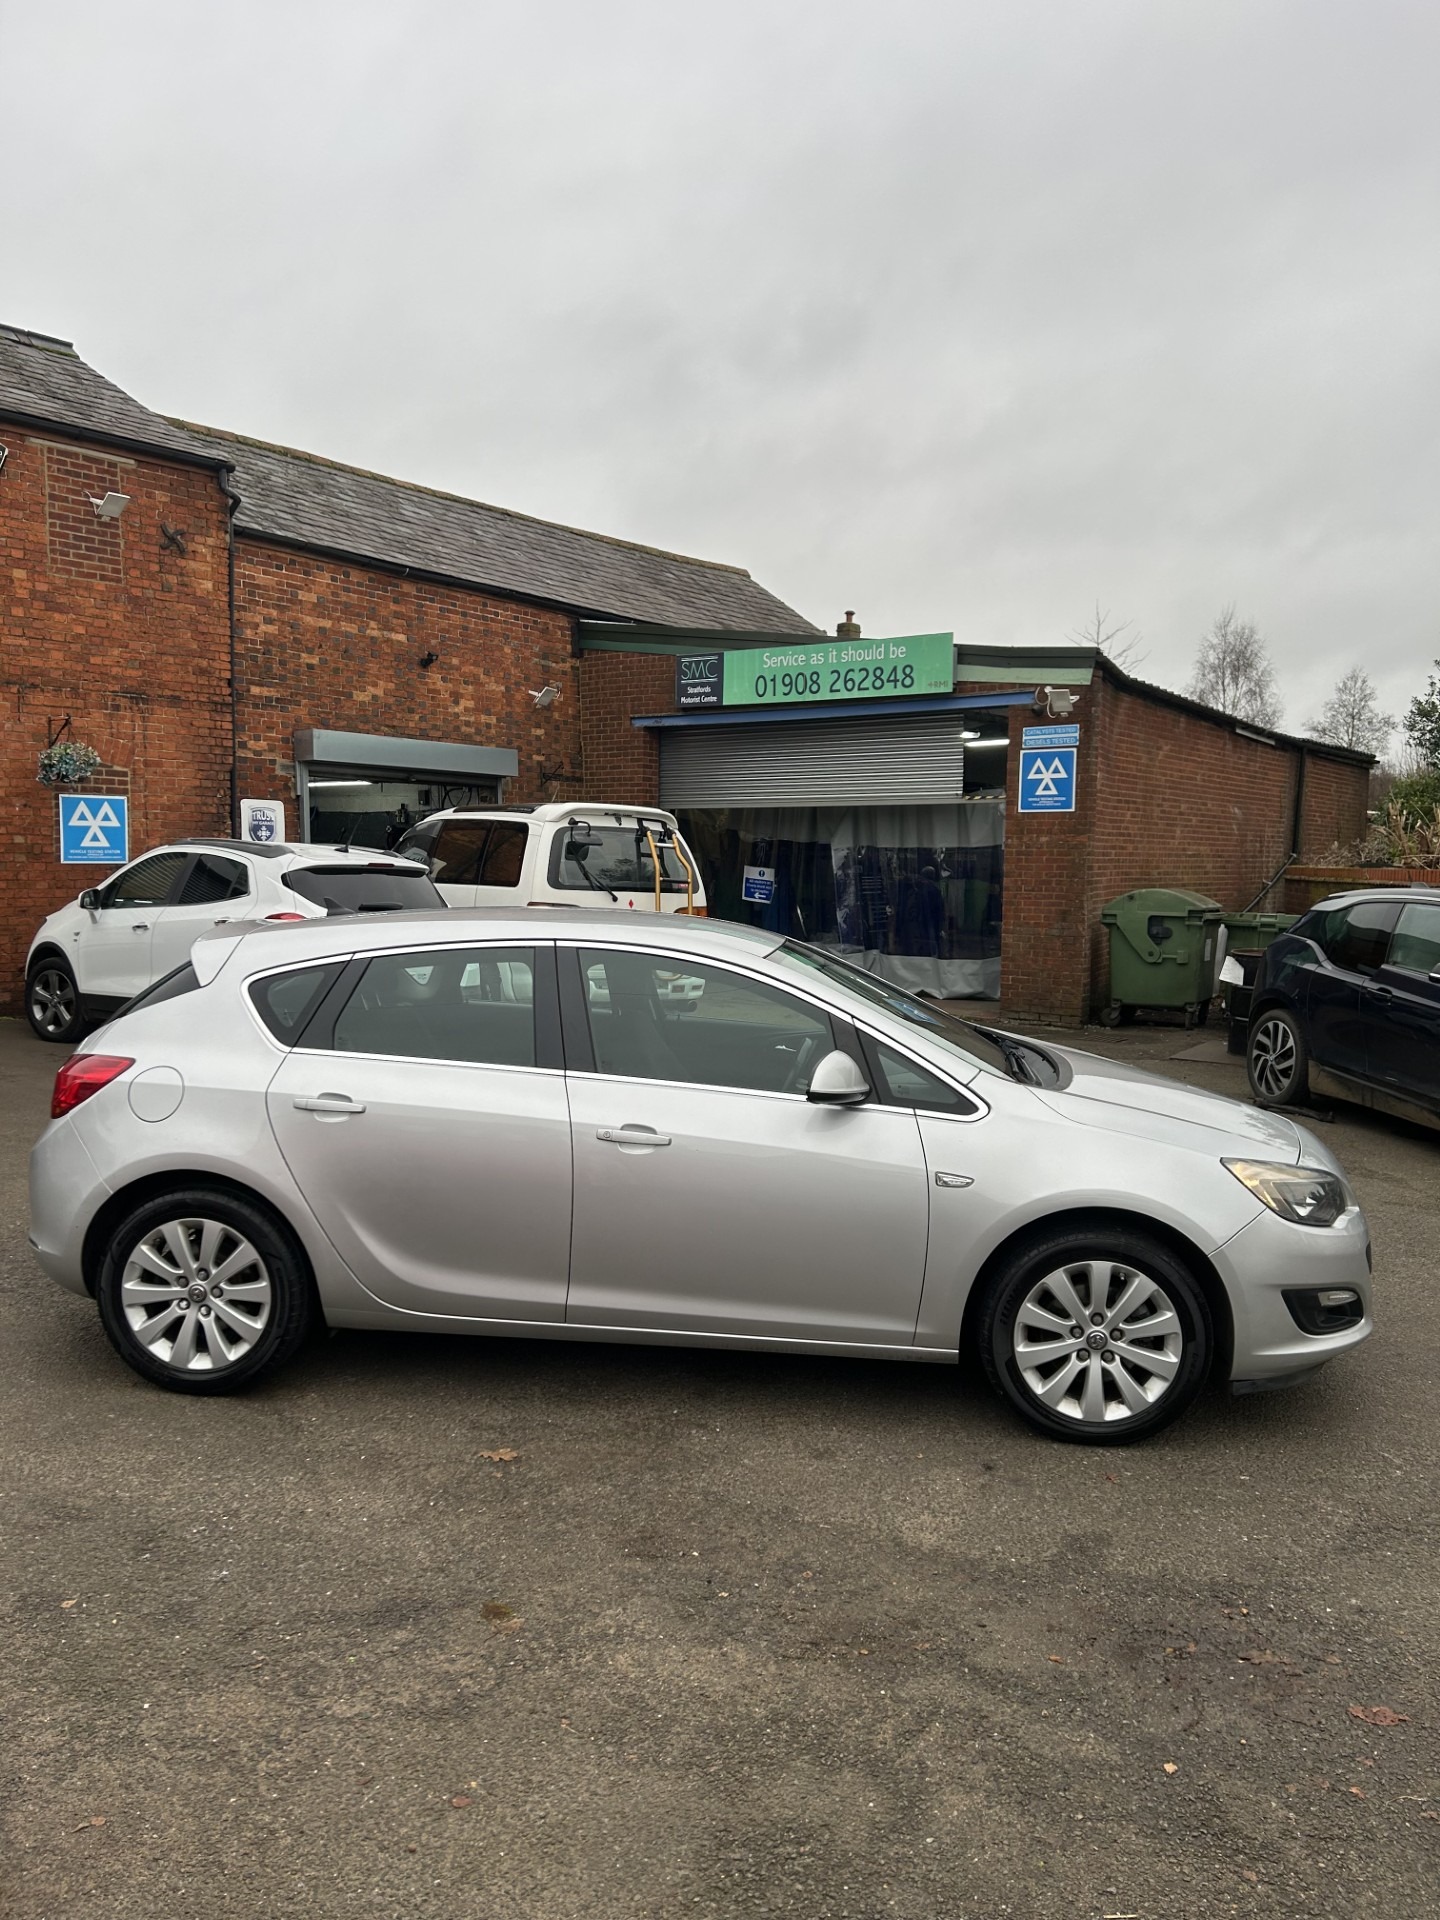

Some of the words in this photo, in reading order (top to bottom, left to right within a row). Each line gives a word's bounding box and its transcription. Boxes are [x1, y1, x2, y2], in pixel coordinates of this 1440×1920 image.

[763, 651, 806, 668] Service
[810, 653, 824, 665] as
[828, 647, 837, 664] it
[841, 644, 885, 663] should
[889, 643, 906, 659] be
[681, 660, 718, 680] SMC
[755, 671, 821, 698] 01908
[829, 664, 915, 693] 262848
[687, 685, 712, 694] Stratfords
[680, 696, 700, 704] Motorist
[701, 695, 718, 703] Centre
[1026, 728, 1055, 736] CATALYSTS
[1056, 726, 1077, 734] TESTED
[1026, 738, 1051, 746] DIESELS
[1051, 737, 1076, 745] TESTED
